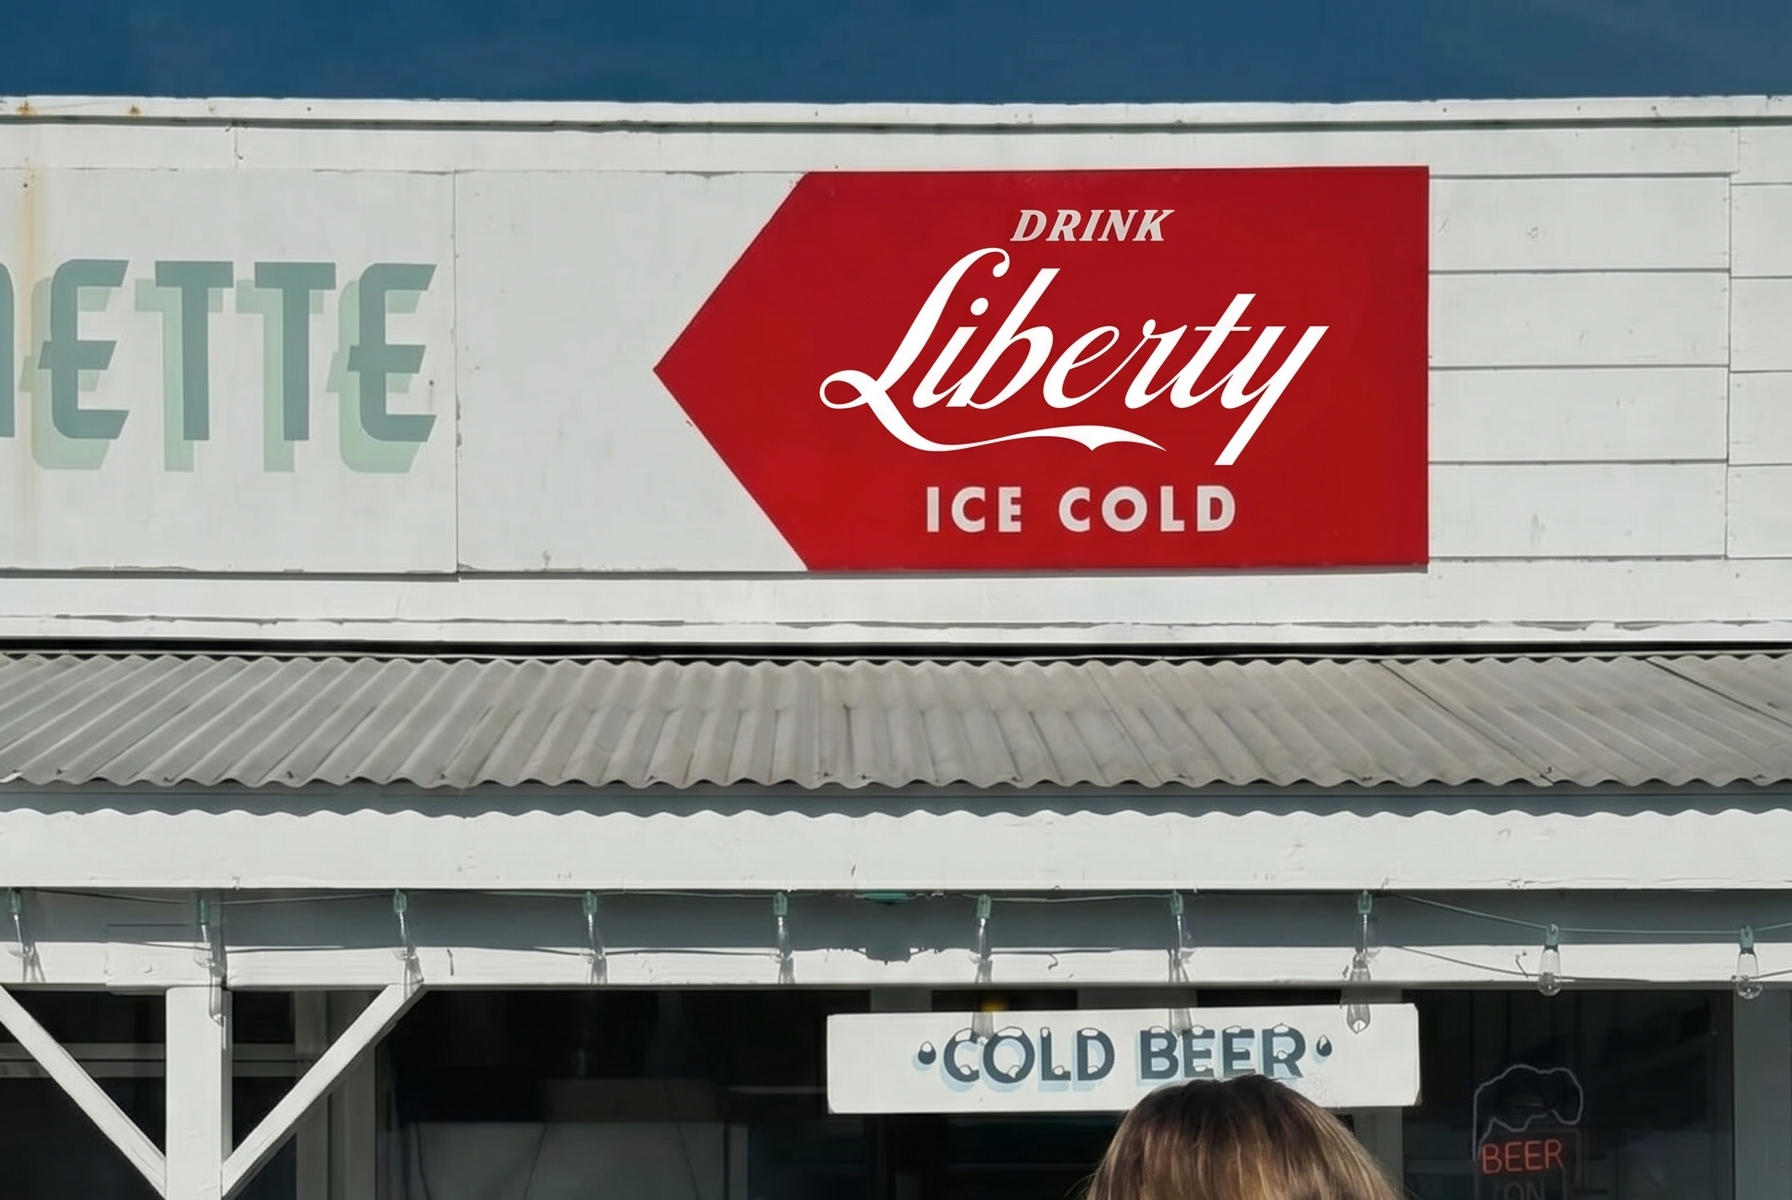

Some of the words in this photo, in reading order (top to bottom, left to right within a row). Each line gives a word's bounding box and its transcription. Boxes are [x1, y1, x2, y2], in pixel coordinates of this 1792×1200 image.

[1010, 208, 1175, 242] DRINK
[0, 258, 437, 442] ETTE
[819, 247, 1330, 466] Liberty
[926, 485, 1022, 533] ICE
[1058, 484, 1236, 533] COLD
[942, 1025, 1116, 1084] COLD
[1139, 1024, 1307, 1080] BEER
[1481, 1138, 1564, 1175] BEER
